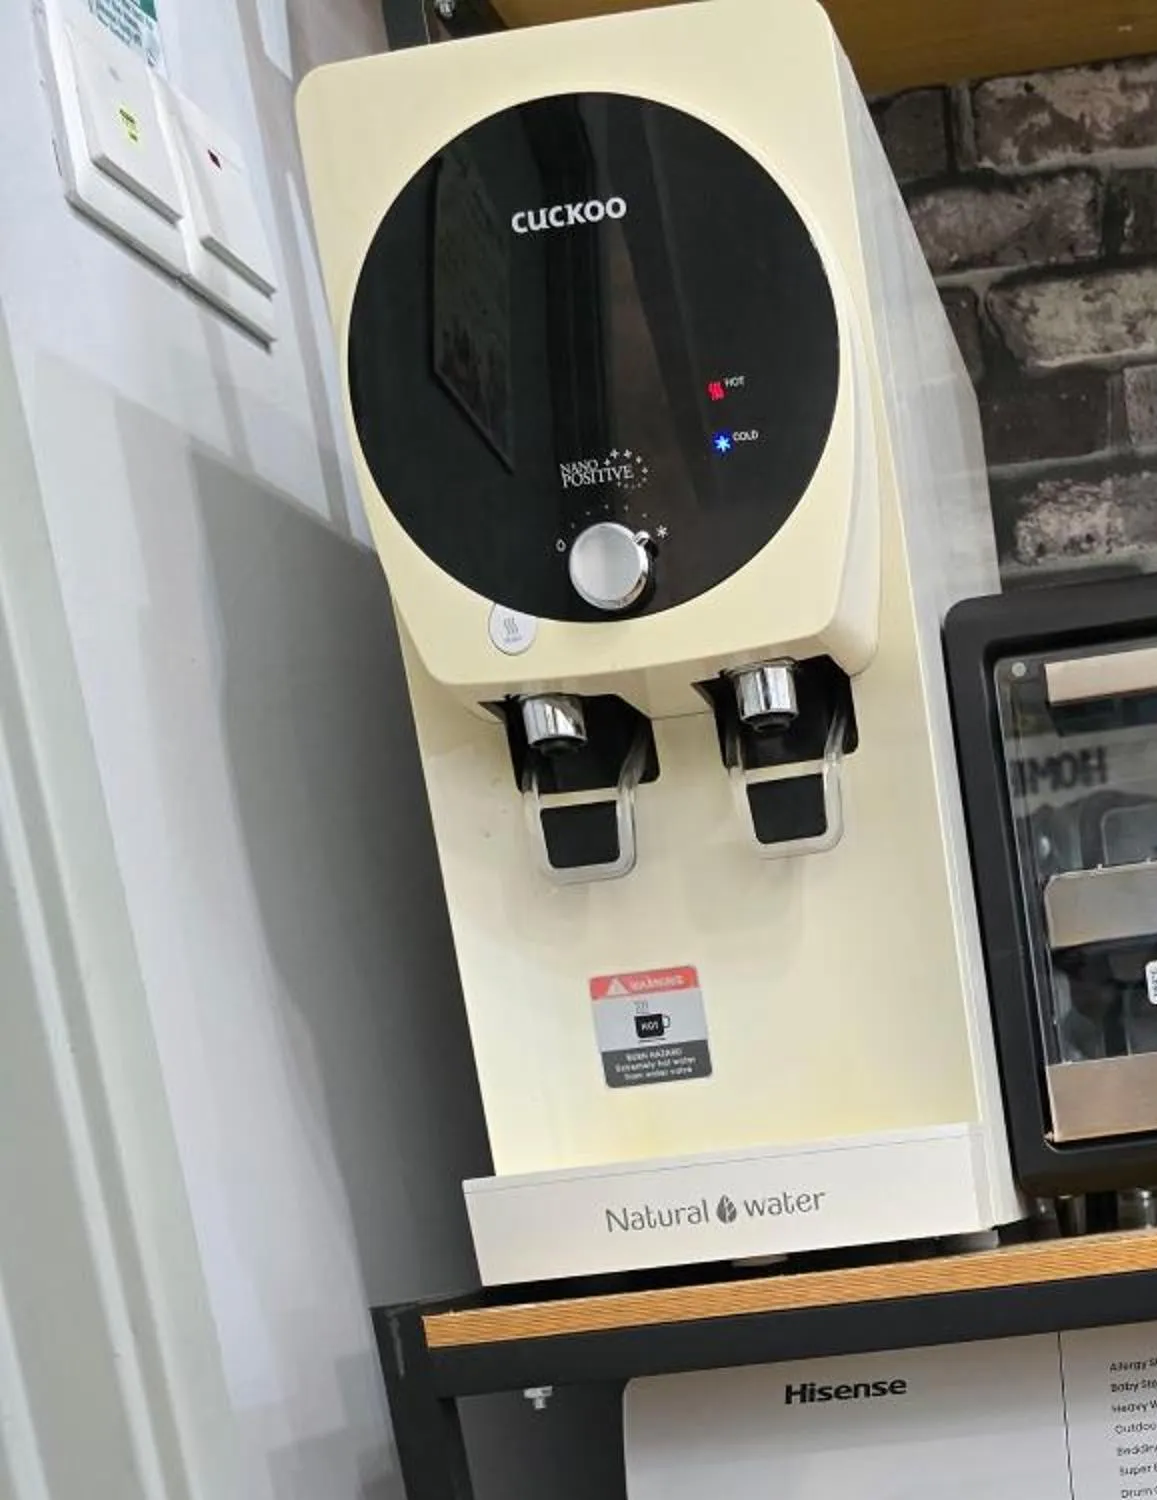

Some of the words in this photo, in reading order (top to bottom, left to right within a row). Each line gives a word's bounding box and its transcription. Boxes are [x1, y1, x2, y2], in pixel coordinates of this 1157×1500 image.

[511, 196, 627, 233] CUCKOO
[725, 376, 745, 388] HOT
[733, 430, 758, 442] COLD
[560, 458, 599, 475] NANO
[561, 463, 634, 488] POSITIVE
[605, 1198, 709, 1233] Natural
[743, 1191, 826, 1217] water
[785, 1378, 907, 1404] Hisense
